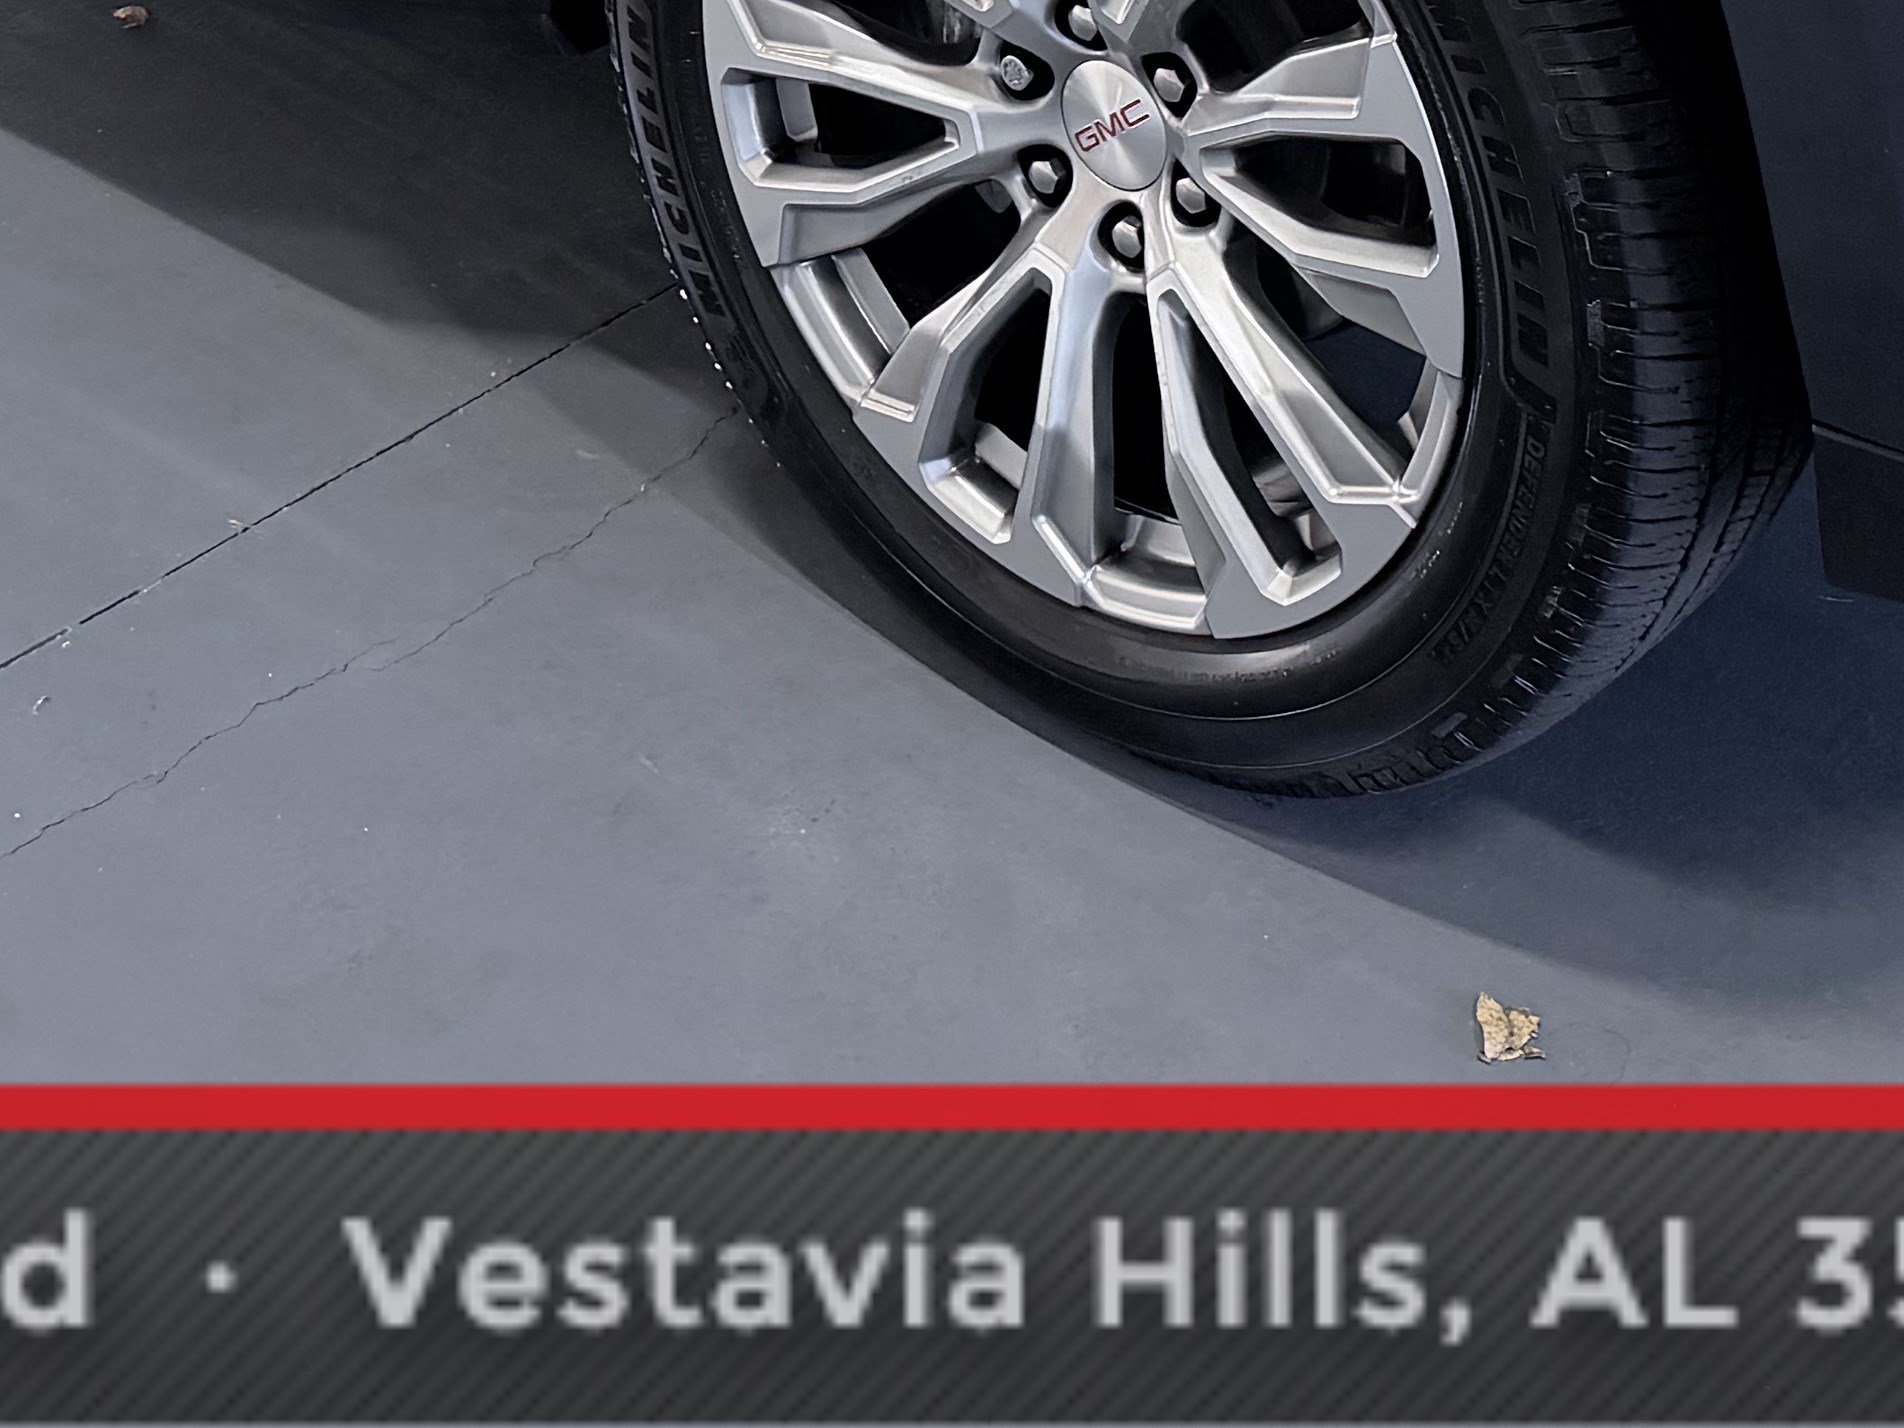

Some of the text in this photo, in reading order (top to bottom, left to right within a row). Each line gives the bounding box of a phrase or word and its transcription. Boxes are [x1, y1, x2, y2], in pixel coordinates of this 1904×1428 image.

[625, 3, 727, 319] MICHELIN
[1074, 98, 1150, 152] GMC
[1494, 433, 1547, 568] DEFENDER
